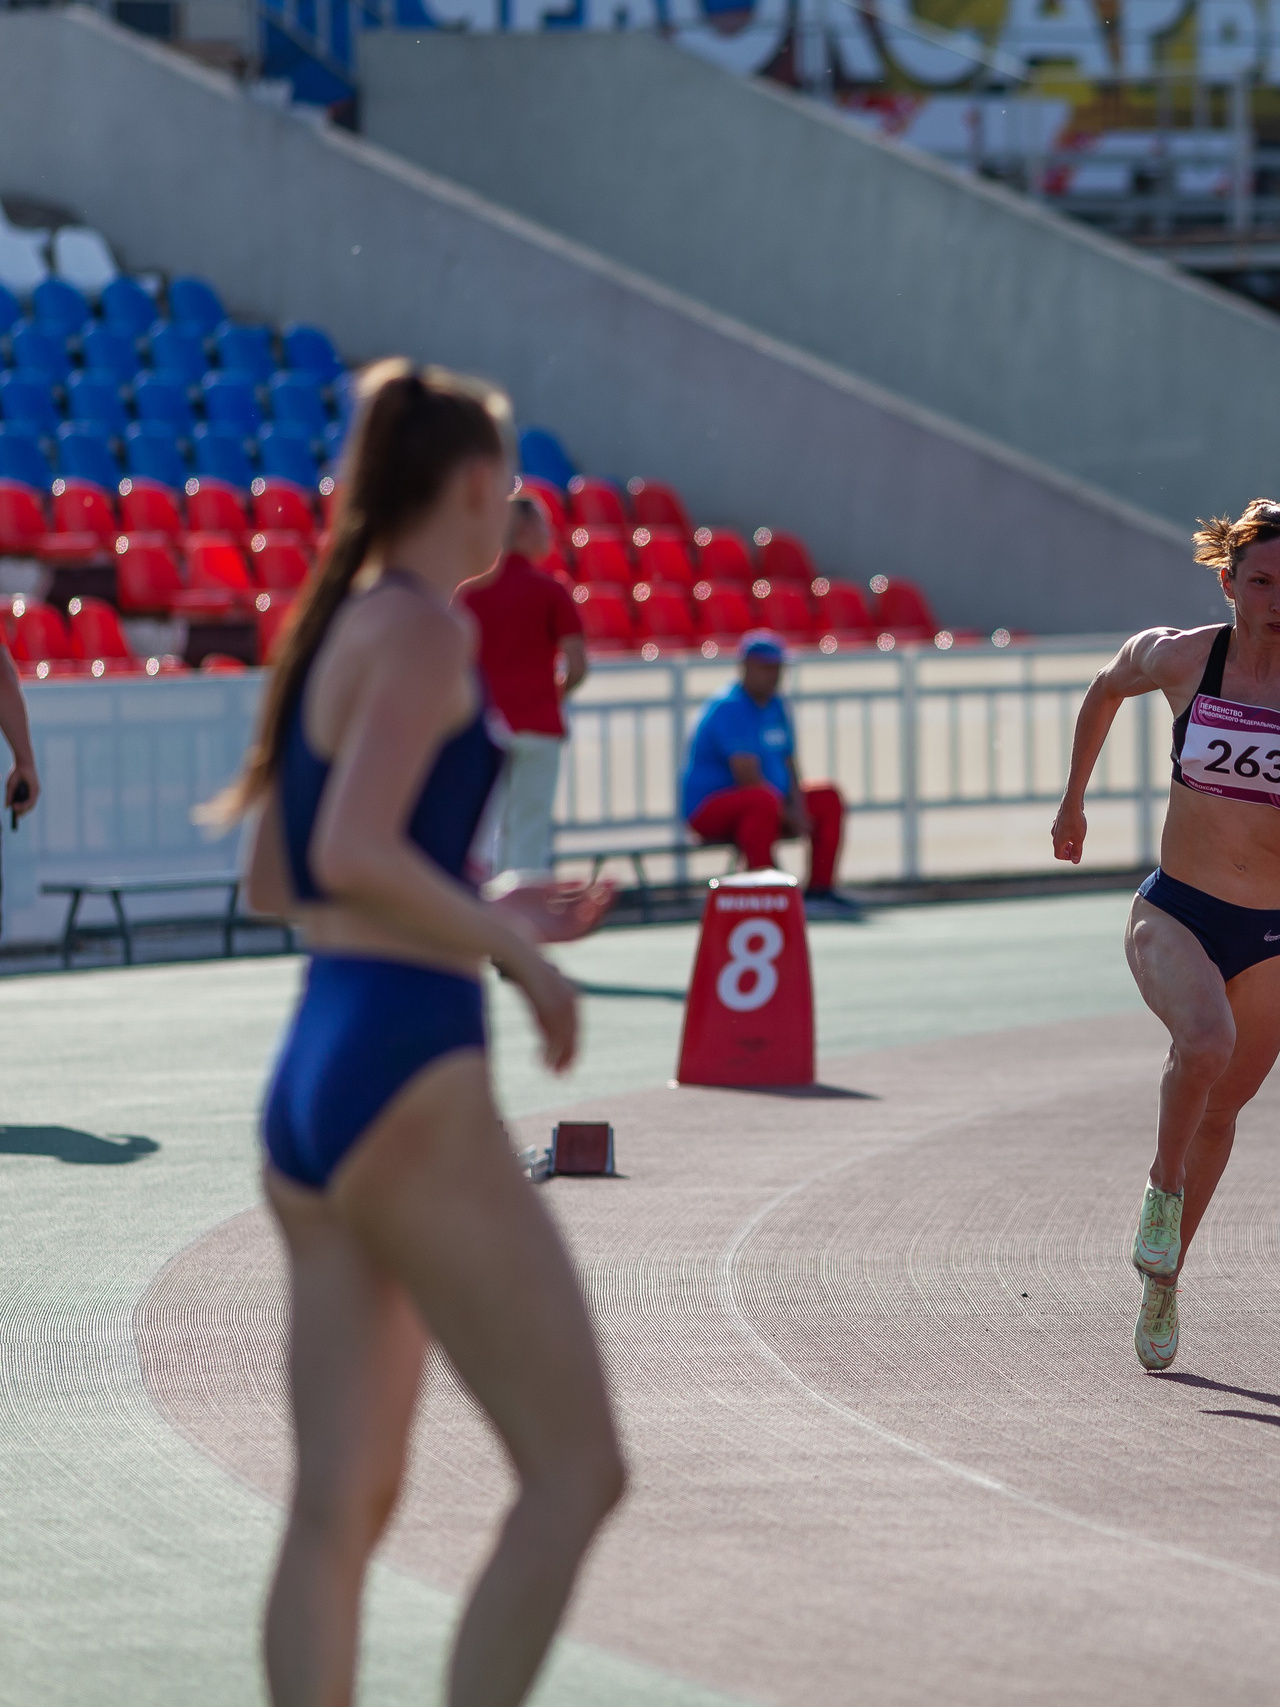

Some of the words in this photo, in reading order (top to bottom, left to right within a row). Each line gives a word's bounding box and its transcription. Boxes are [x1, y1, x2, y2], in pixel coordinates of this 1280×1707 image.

[1199, 709, 1238, 722] ПРИВОЛЖСКОГО
[1239, 718, 1280, 730] ФЕДЕРАЛЬНОГО
[1200, 702, 1242, 716] ПЕРВЕНСТВО
[717, 918, 783, 1011] 8
